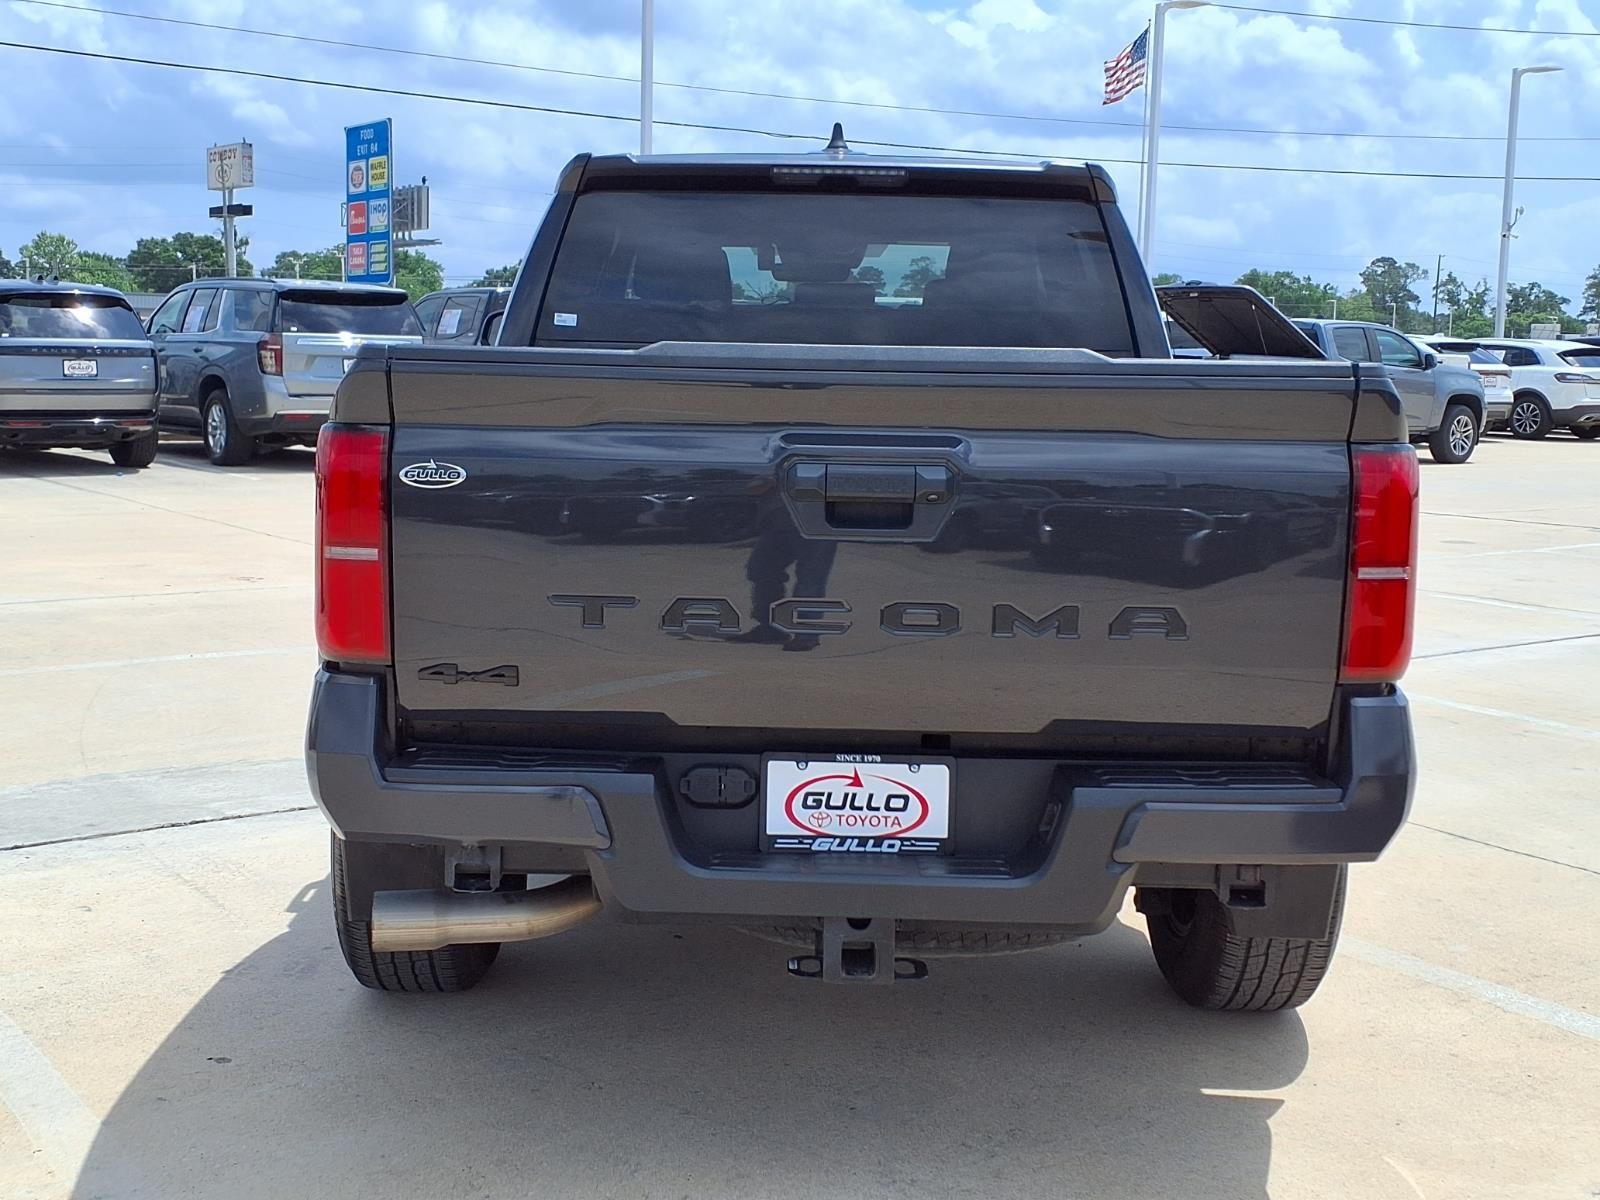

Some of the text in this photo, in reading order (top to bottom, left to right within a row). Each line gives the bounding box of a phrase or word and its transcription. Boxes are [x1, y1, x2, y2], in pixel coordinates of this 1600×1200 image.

[360, 129, 374, 140] FOOD
[357, 144, 368, 156] EXIT
[370, 160, 386, 171] WAFFLE
[371, 171, 386, 182] HOUSE
[404, 470, 461, 480] GULLO
[546, 594, 1190, 641] TACOMA
[836, 754, 881, 763] SINCE 1970
[801, 791, 910, 812] GULLO
[837, 814, 902, 828] TOYOTA
[811, 838, 902, 853] GULLO
